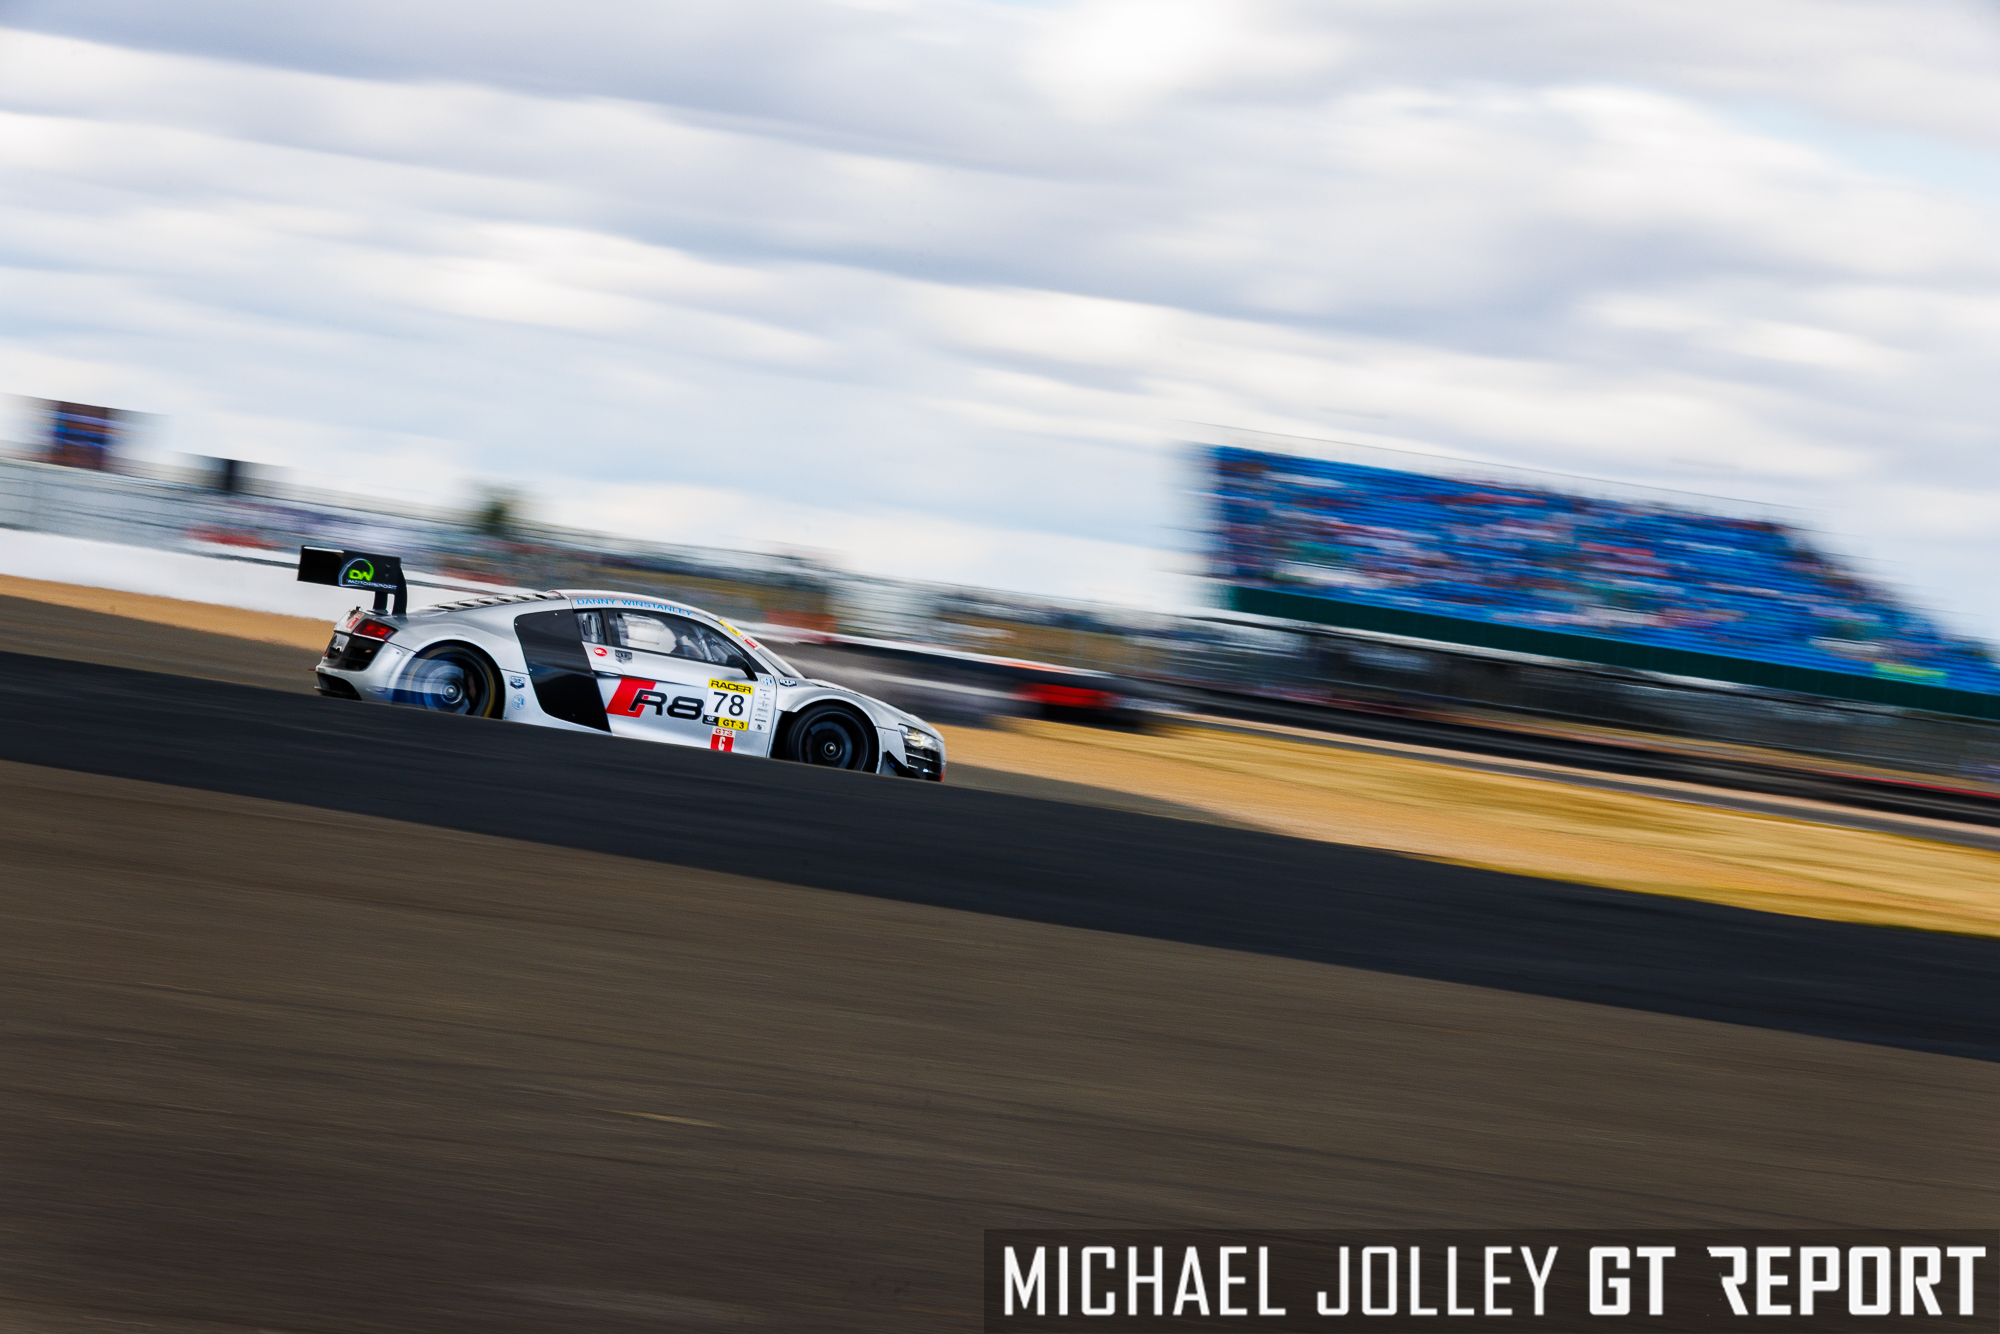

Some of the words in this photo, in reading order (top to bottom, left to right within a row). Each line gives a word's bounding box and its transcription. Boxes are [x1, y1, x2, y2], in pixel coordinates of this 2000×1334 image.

[621, 600, 693, 616] WINSTANLEY
[711, 680, 752, 694] RACER
[627, 689, 705, 720] R8
[713, 691, 744, 716] 78
[715, 728, 733, 736] GT3
[722, 719, 745, 730] GT-3
